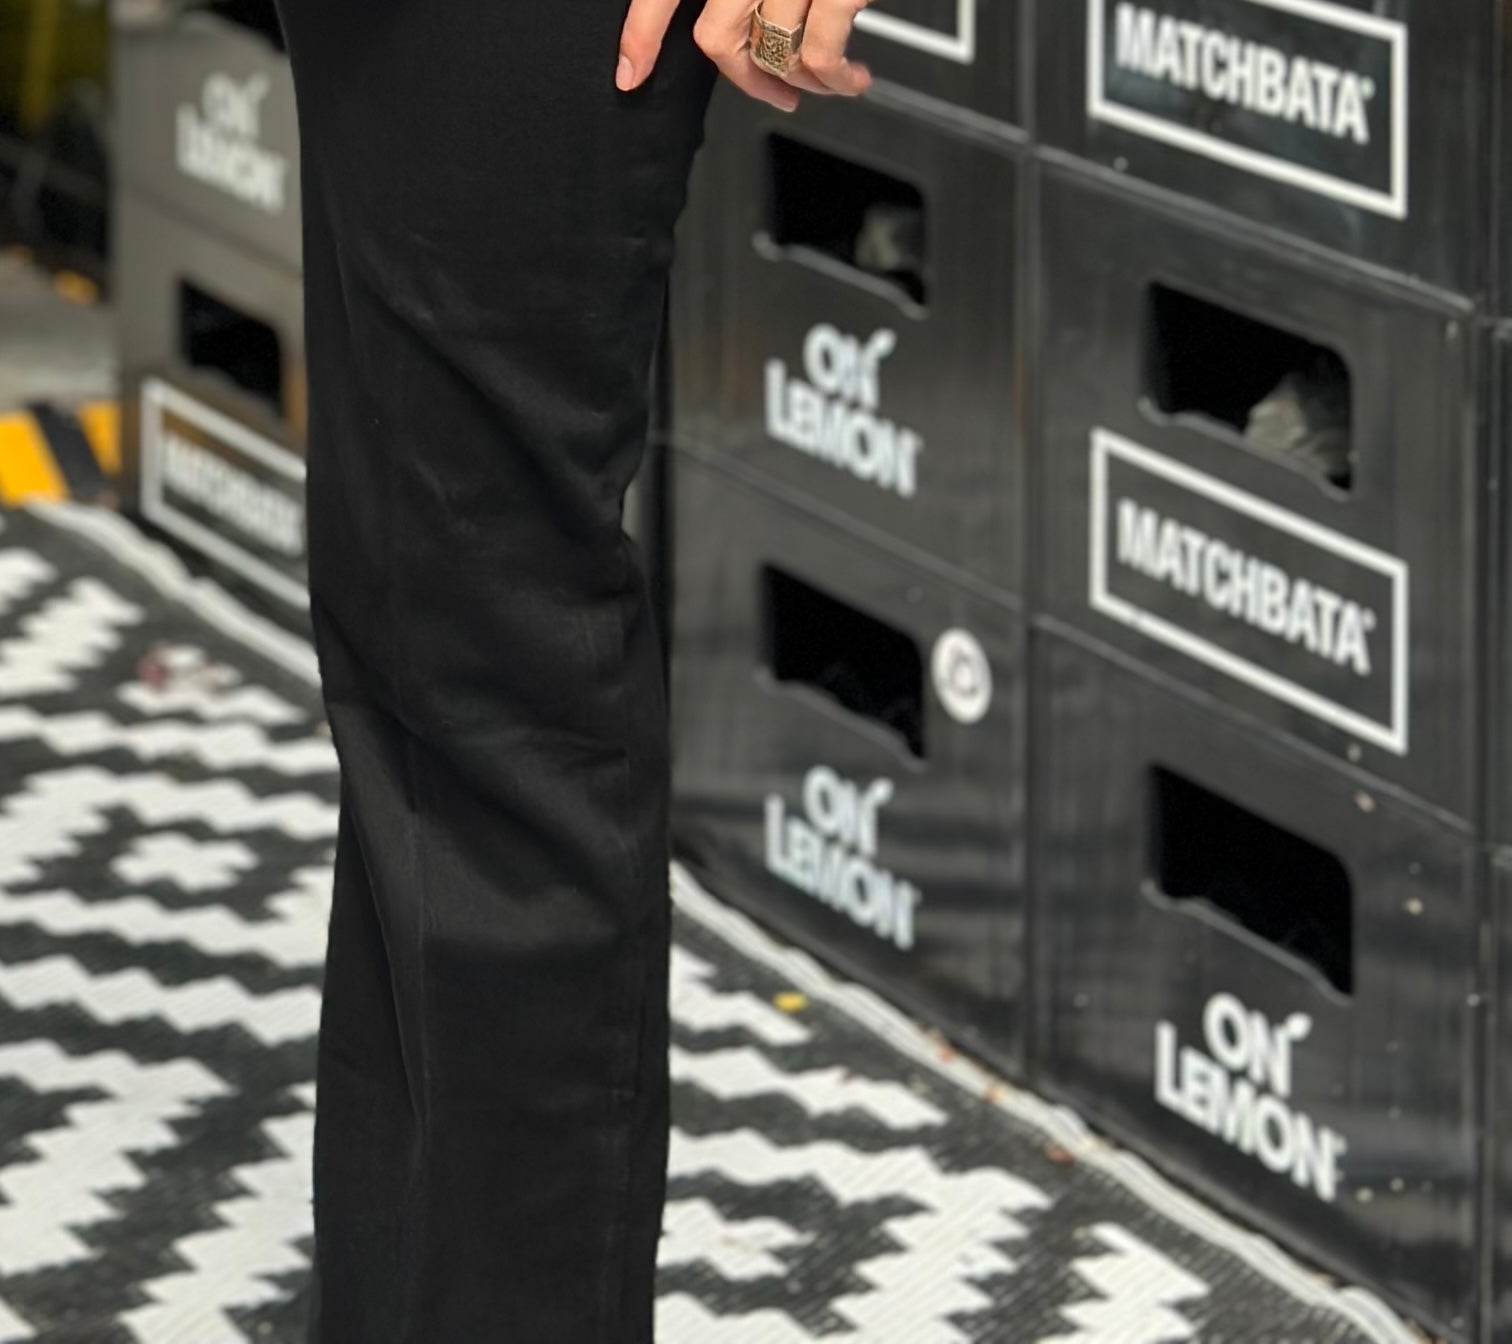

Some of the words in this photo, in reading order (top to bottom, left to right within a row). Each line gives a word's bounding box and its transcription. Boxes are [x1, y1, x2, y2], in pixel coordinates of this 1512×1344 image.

[1115, 0, 1370, 145] MATCHBATA
[765, 356, 918, 499] LEMON
[1118, 498, 1372, 676] MATCHBATA
[764, 793, 918, 951] LEMON
[1155, 1020, 1342, 1203] LEMON
[1202, 991, 1310, 1100] ON
